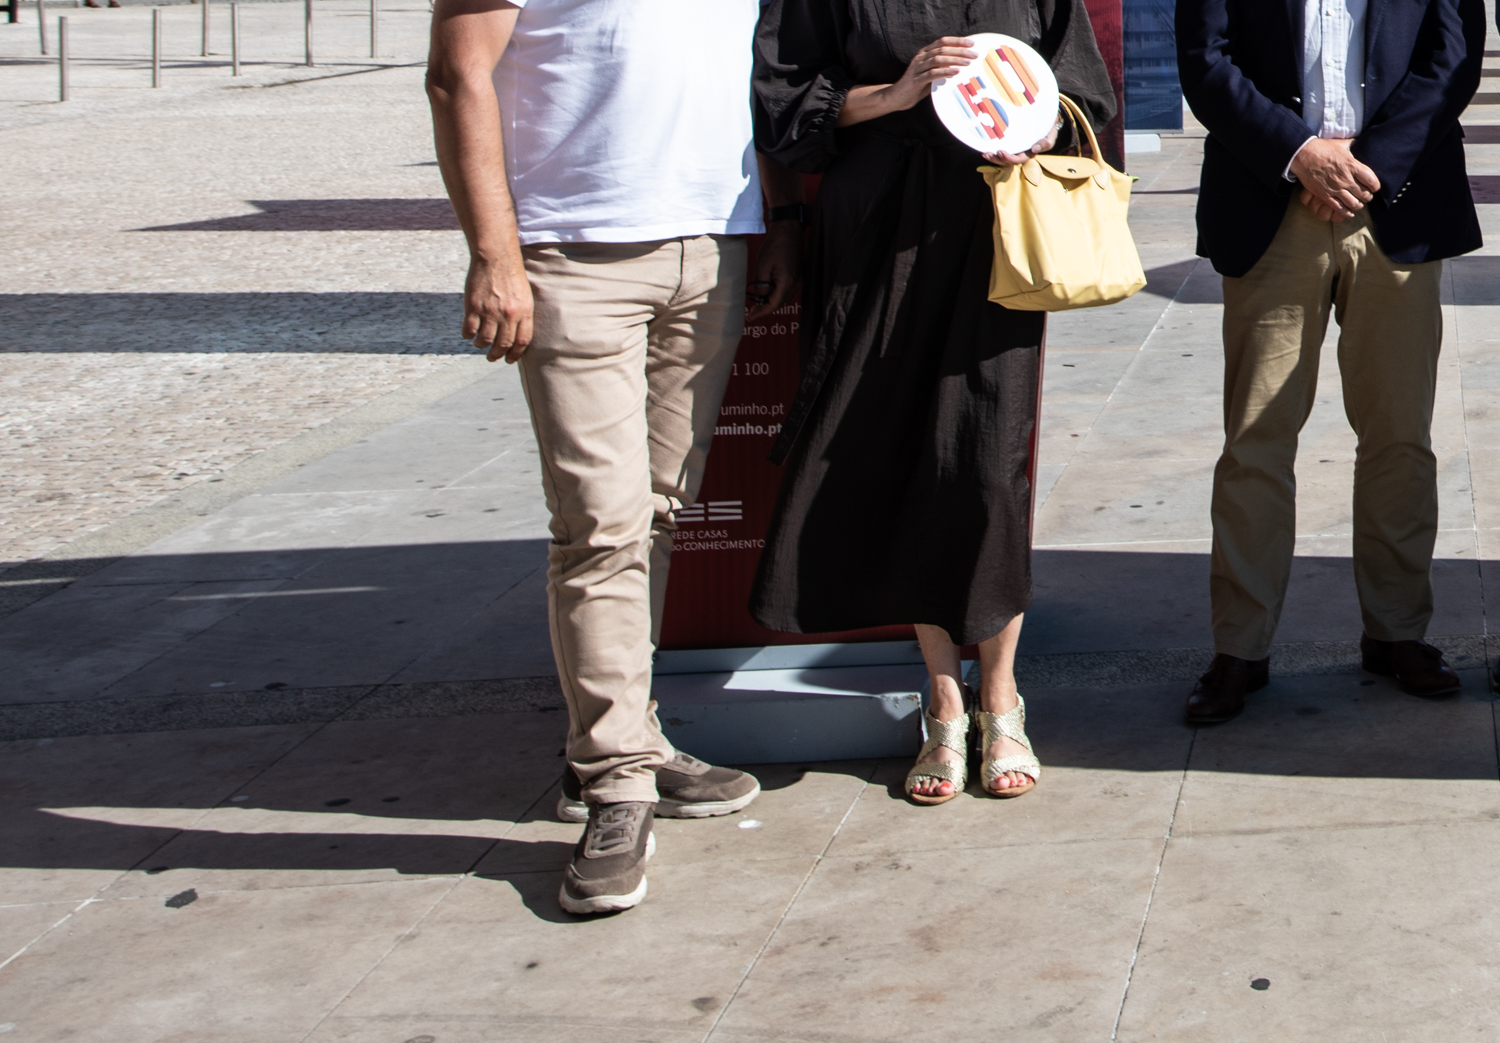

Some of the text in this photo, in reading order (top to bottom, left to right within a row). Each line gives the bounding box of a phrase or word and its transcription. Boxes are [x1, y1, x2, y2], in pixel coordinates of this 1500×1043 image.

[771, 322, 788, 336] do
[745, 362, 769, 376] 100
[697, 529, 728, 539] CASAS
[683, 539, 766, 551] CONHECIMENTO
